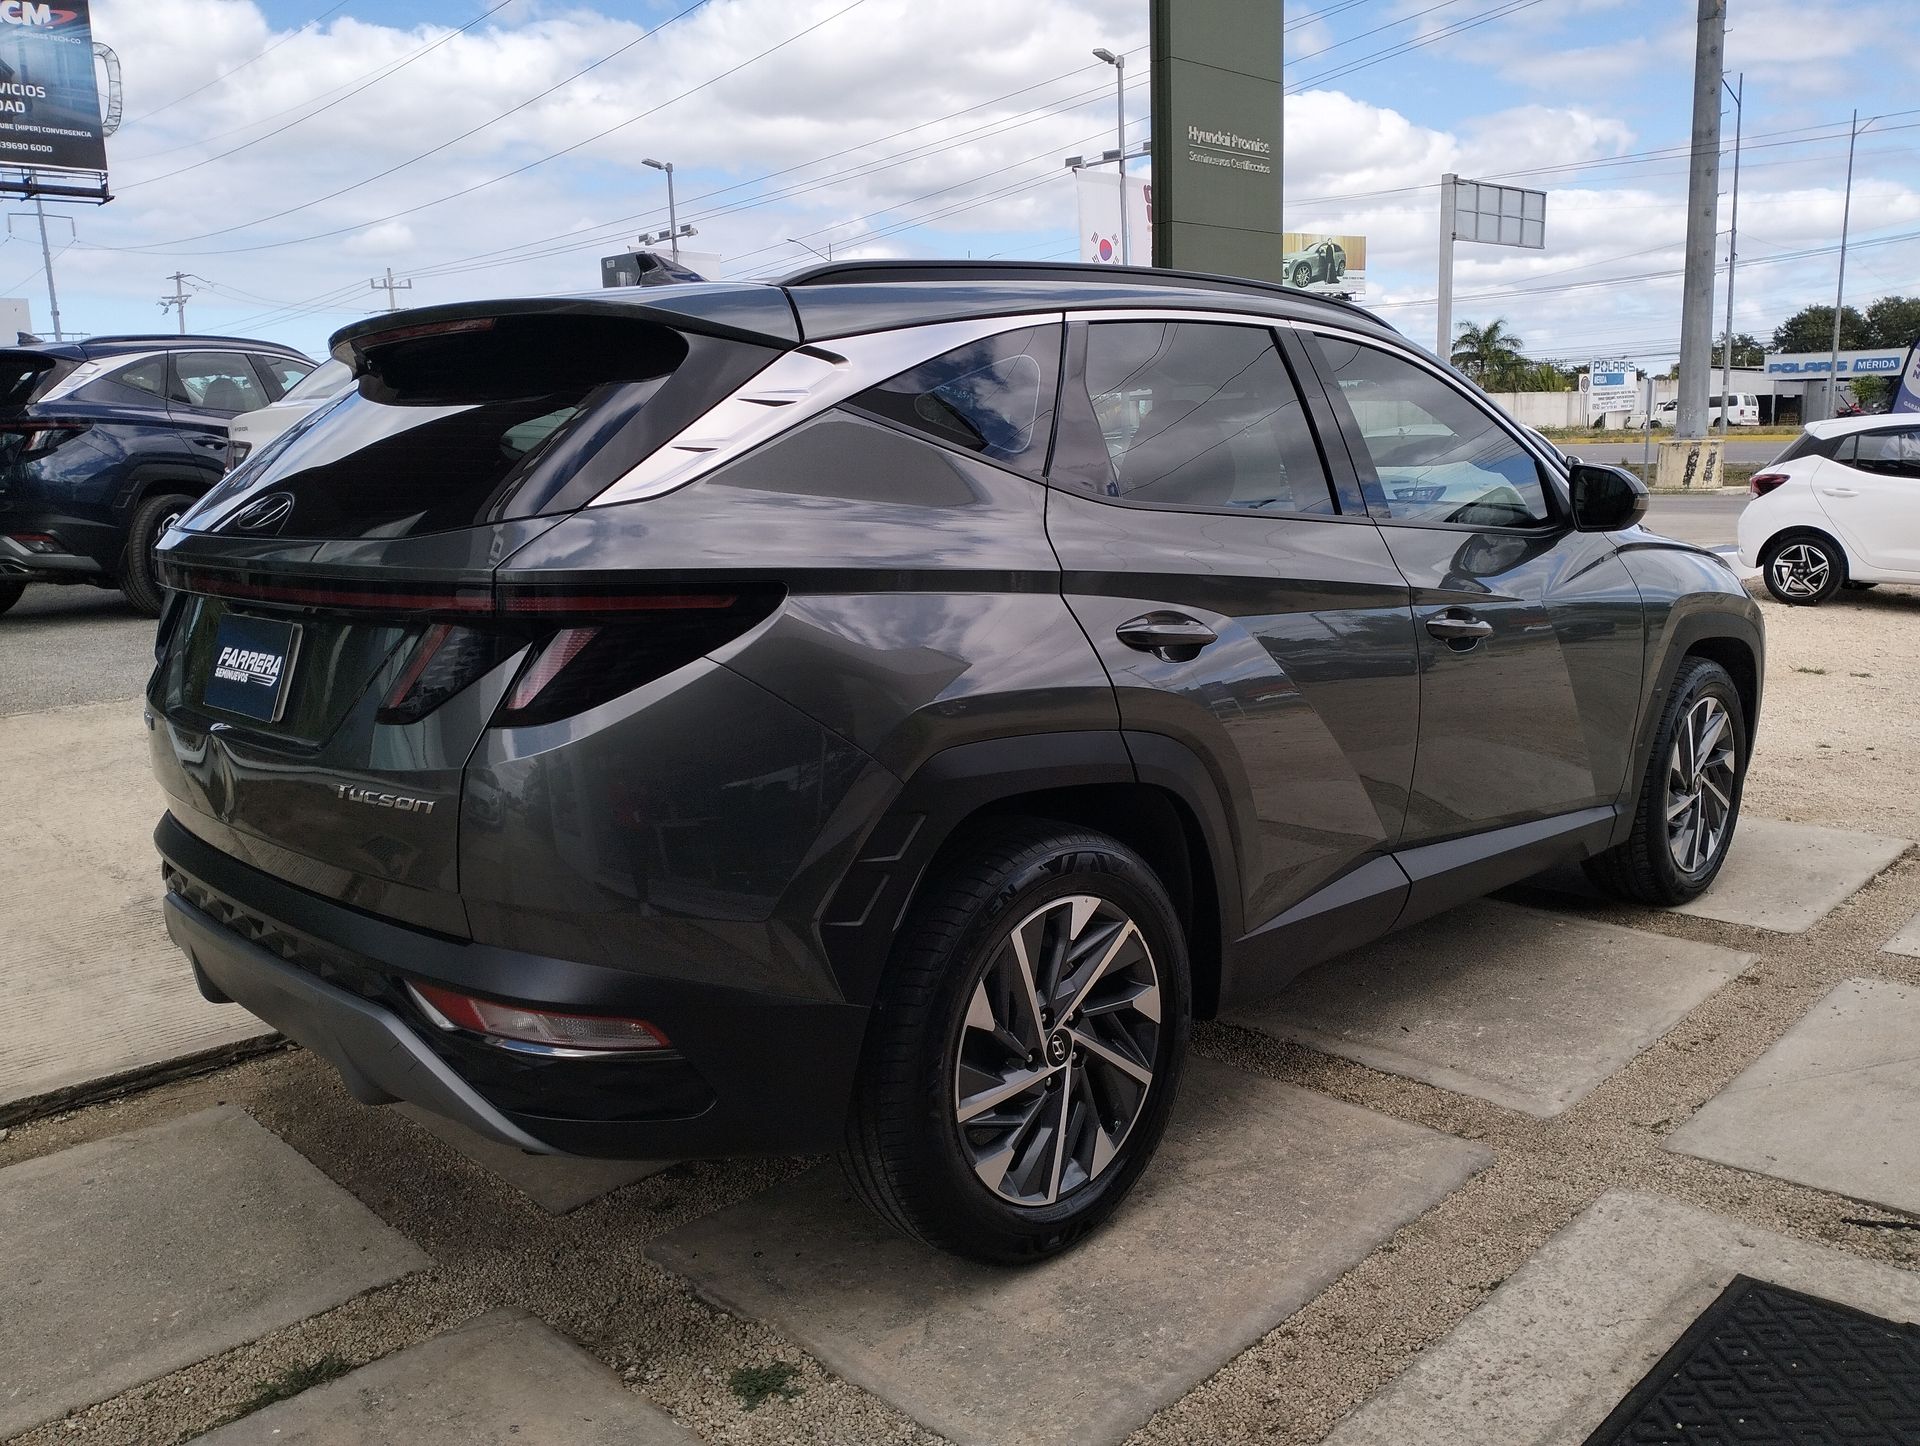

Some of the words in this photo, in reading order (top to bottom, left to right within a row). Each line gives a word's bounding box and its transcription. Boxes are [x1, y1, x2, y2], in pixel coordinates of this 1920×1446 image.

[0, 0, 51, 26] CM
[42, 126, 92, 138] CONVERGENCIA
[1188, 125, 1231, 147] Hyundai
[1231, 134, 1270, 154] Promise
[0, 141, 29, 151] 39690
[30, 143, 53, 153] 6000
[1593, 360, 1636, 373] POLARIS
[1768, 360, 1848, 374] POLARS
[1857, 358, 1896, 370] MÉRIDA
[217, 646, 283, 676] FARRERA
[214, 666, 249, 684] SEMINUEVOS
